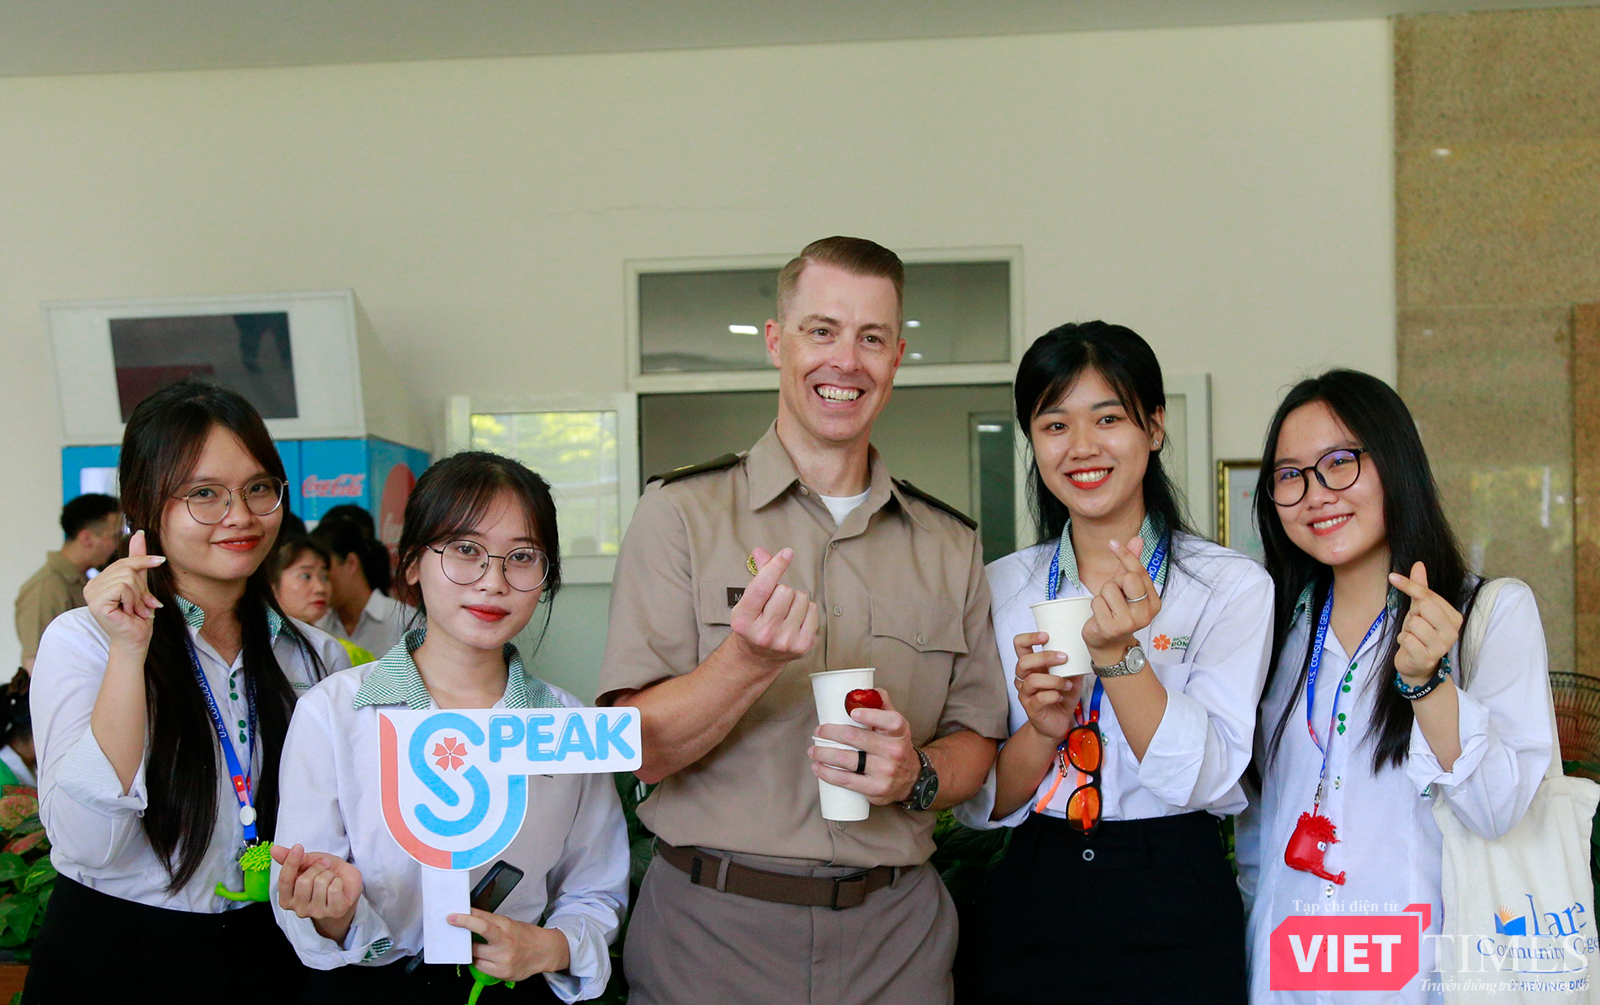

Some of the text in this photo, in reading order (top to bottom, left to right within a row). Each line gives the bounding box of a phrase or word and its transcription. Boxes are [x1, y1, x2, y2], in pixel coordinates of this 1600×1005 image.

[1150, 551, 1163, 567] CHI
[1309, 624, 1326, 668] CONSULATE
[1307, 667, 1317, 685] U.S.
[195, 671, 219, 720] CONSULATE
[216, 721, 227, 739] U.S.
